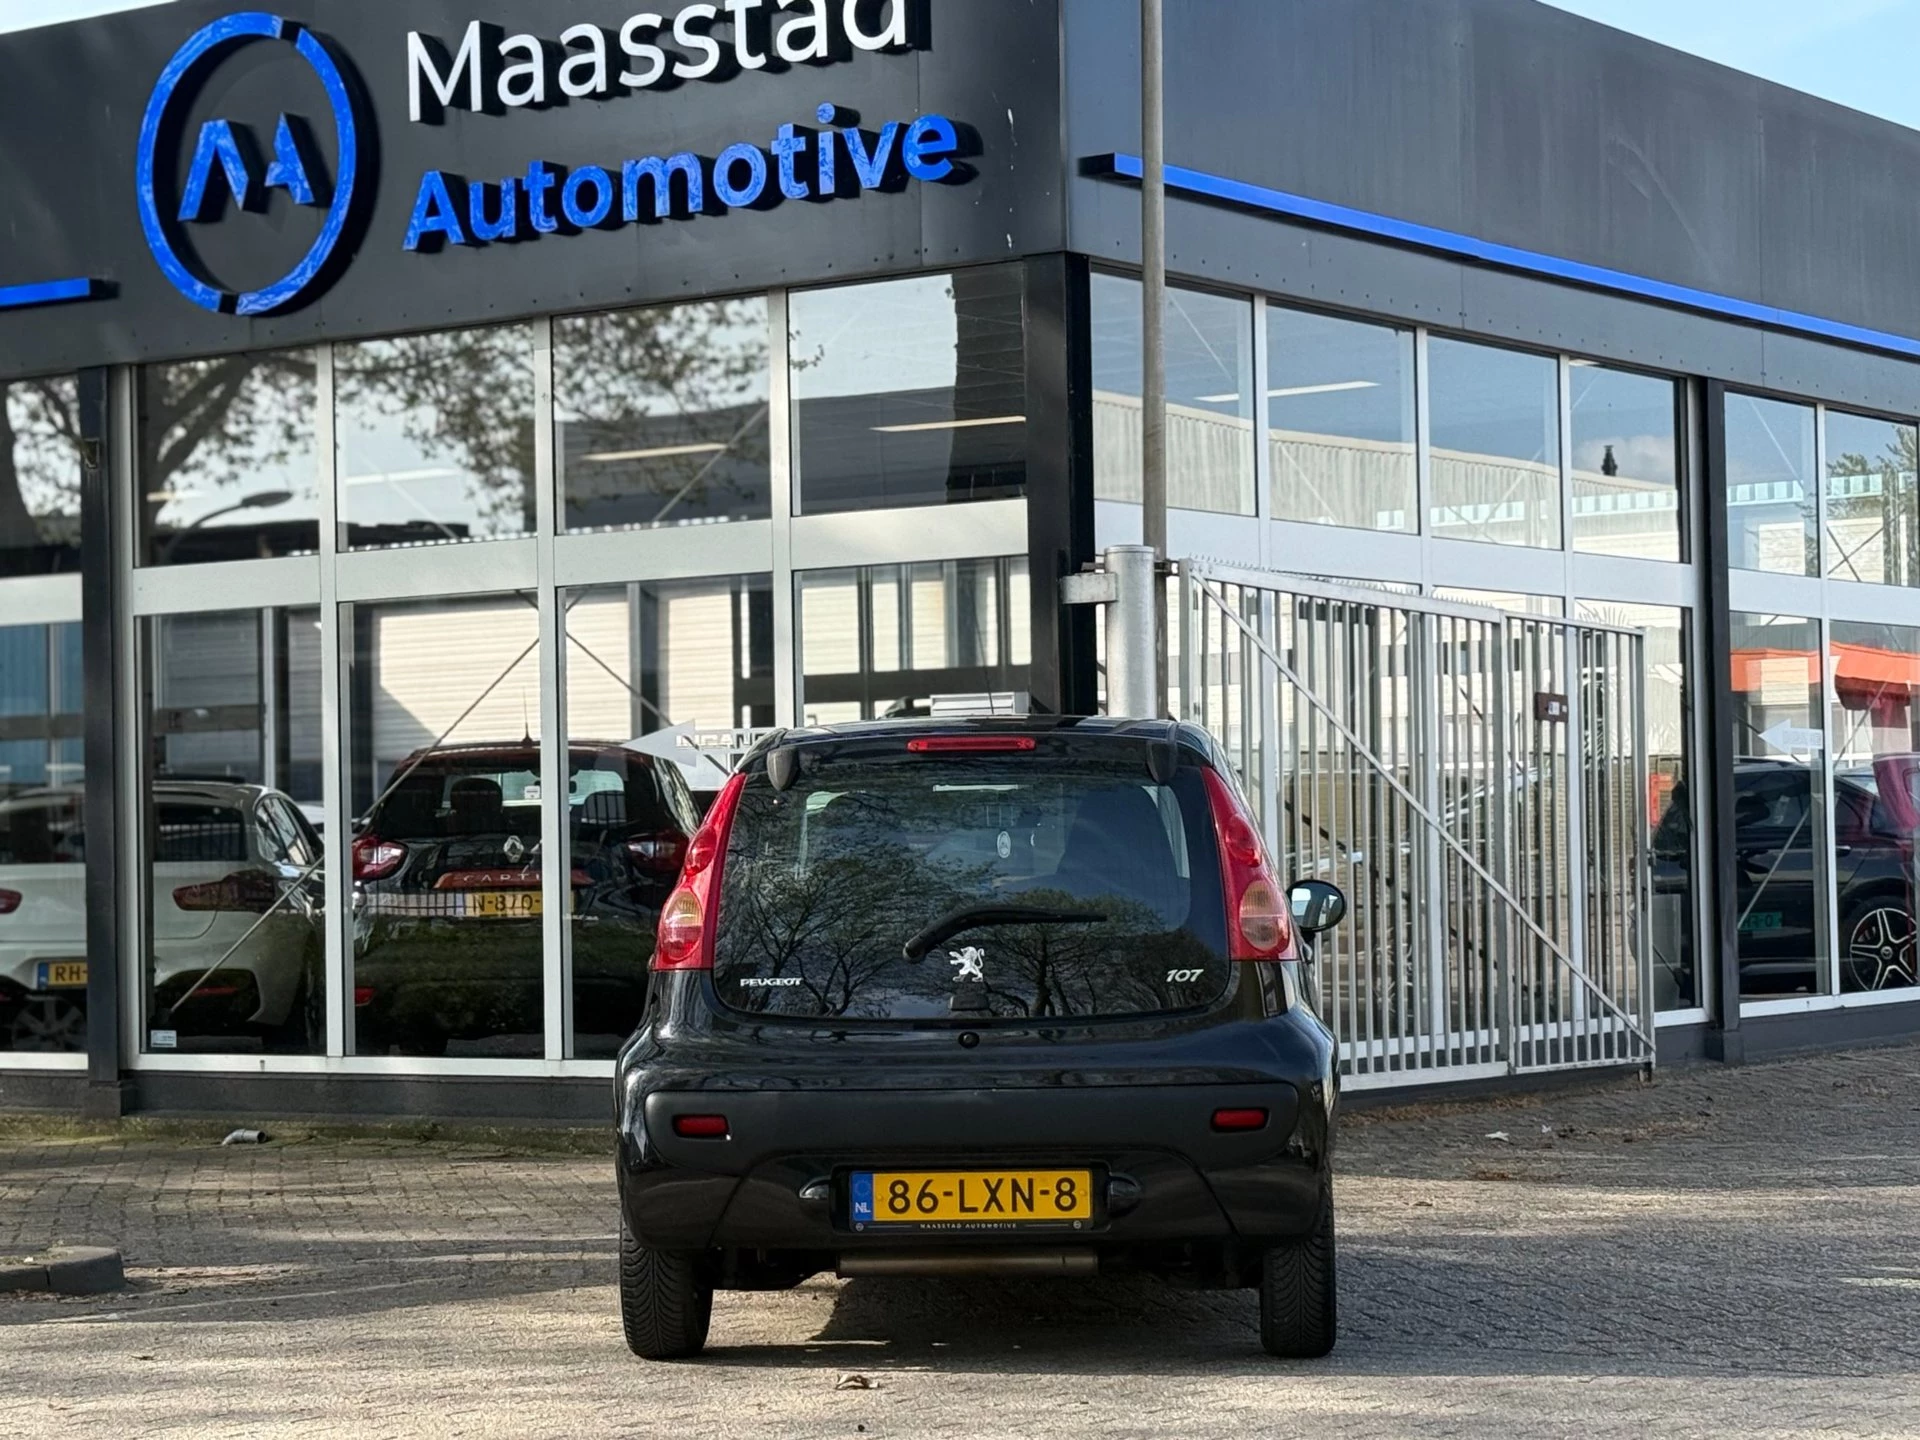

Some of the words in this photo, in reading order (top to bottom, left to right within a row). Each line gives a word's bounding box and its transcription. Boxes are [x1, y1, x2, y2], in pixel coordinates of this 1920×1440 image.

[403, 102, 958, 250] Automotive
[739, 977, 803, 987] PEUGEOT
[1166, 968, 1205, 983] 107
[887, 1176, 1078, 1215] 86-LXN-8
[855, 1202, 871, 1213] NL
[919, 1222, 962, 1230] MAASSTAD
[964, 1222, 1018, 1230] AUTOMOTIVE
